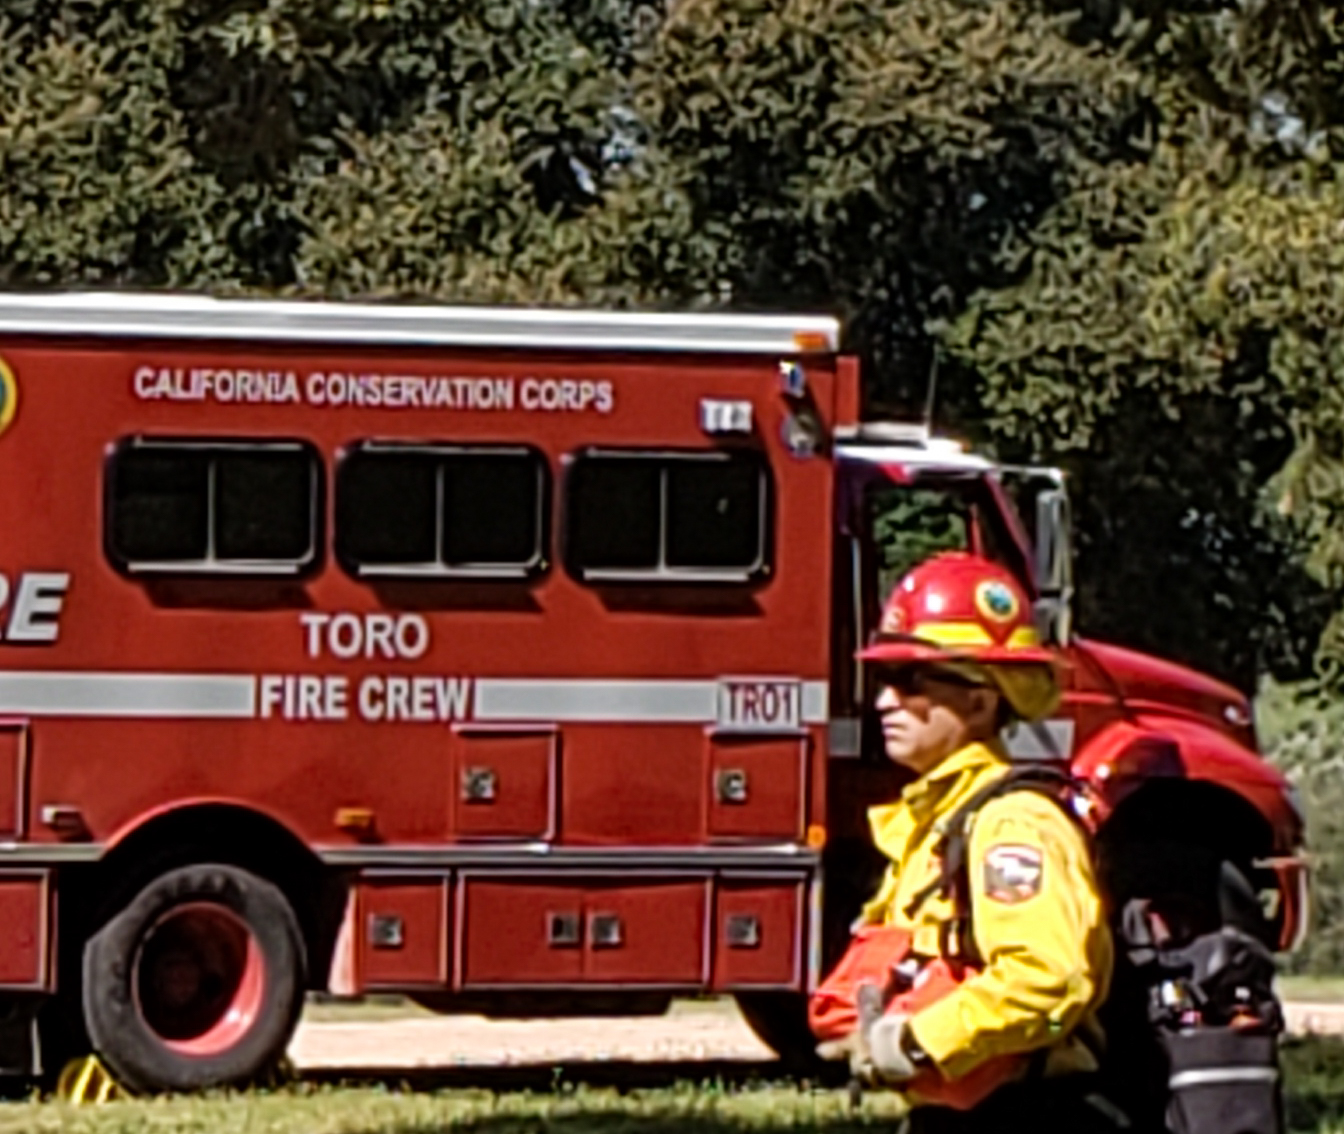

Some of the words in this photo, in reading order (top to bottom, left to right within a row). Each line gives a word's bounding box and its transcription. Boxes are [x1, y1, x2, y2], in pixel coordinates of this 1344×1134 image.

[133, 367, 300, 403] CALIFORNIA
[306, 372, 513, 410] CONSERVATION
[519, 379, 614, 412] CORPS
[300, 613, 430, 659] TORO
[260, 675, 349, 719] FIRE
[359, 677, 471, 721] CREW
